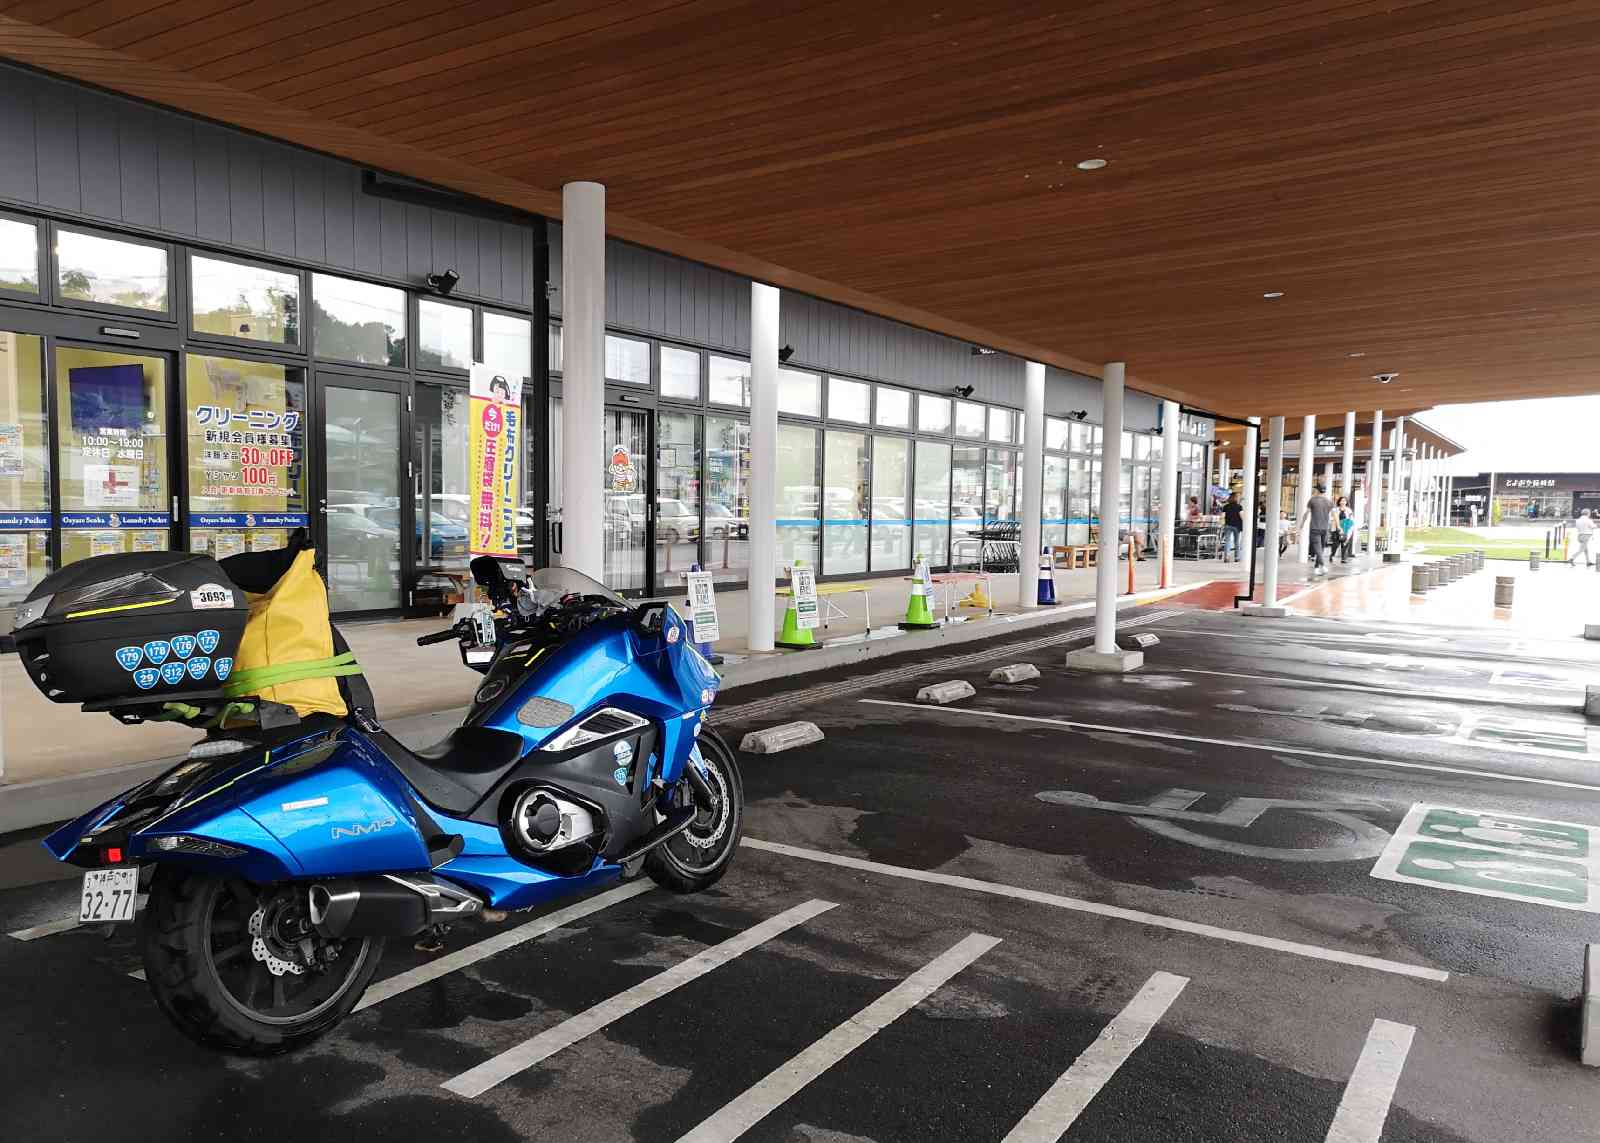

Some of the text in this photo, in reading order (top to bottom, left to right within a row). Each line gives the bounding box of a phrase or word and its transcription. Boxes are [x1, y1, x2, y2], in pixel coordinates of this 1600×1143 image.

[196, 406, 299, 431] クリーニング
[122, 515, 147, 525] Laundry
[199, 591, 225, 602] 3693
[121, 652, 139, 664] 179
